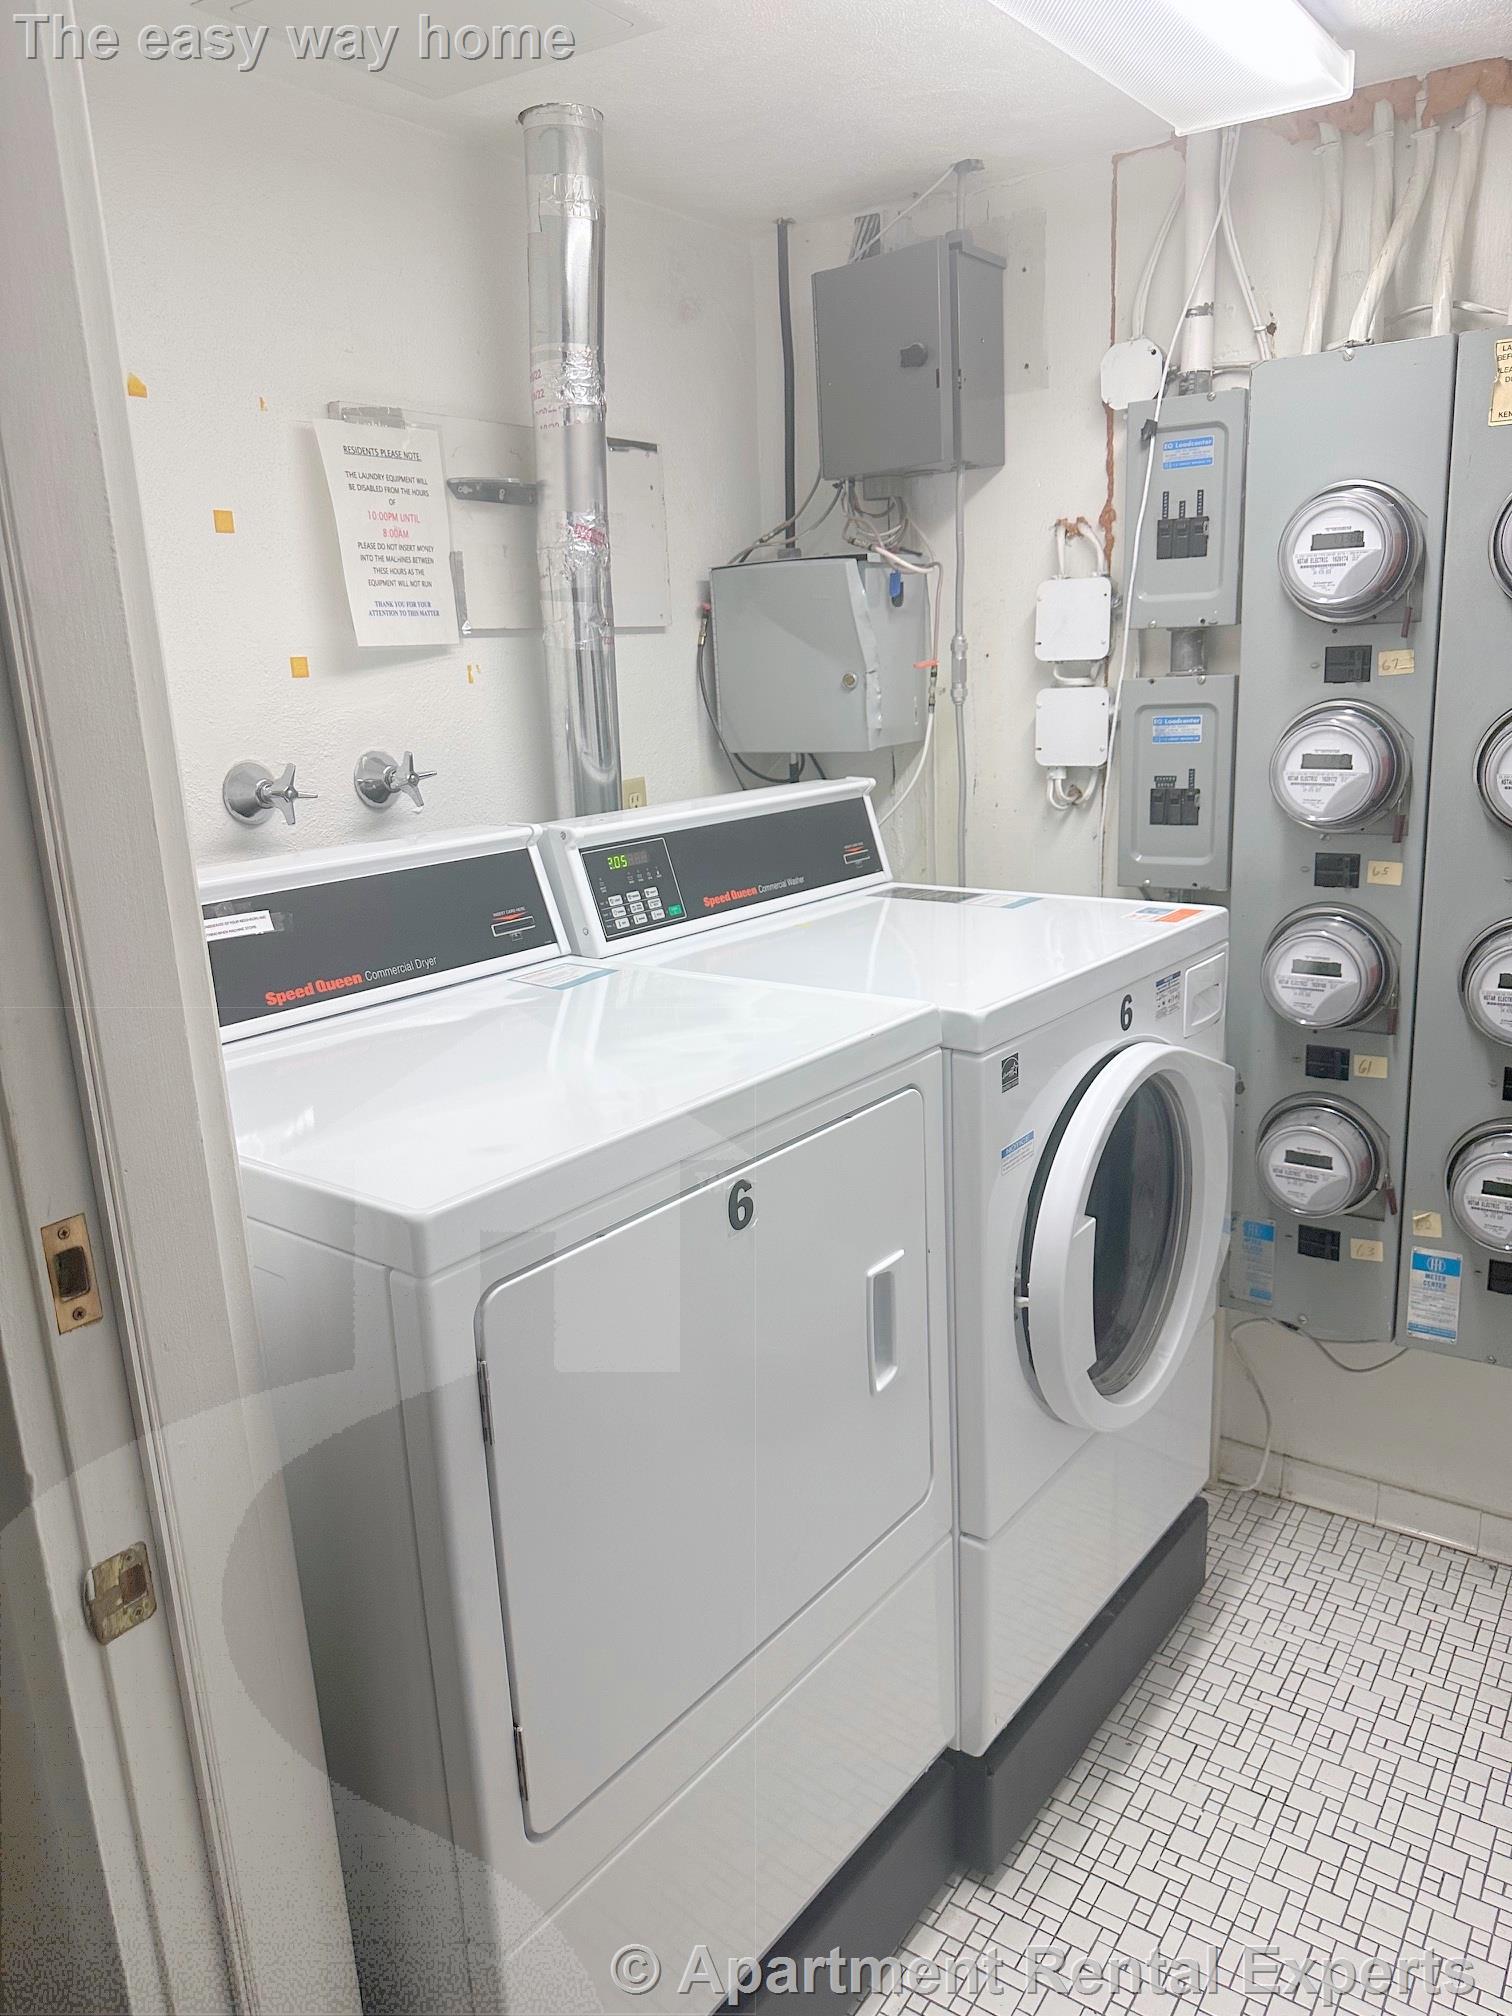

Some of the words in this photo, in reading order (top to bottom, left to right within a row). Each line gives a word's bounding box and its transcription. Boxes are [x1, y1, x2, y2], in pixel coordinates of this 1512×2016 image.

[343, 445, 379, 457] RESIDENTS
[380, 448, 402, 460] PLEASE
[344, 470, 357, 478] THE
[358, 472, 384, 481] LAUNDRY
[386, 474, 415, 484] EQUIPMENT
[357, 484, 383, 492] DISABLED
[412, 489, 429, 497] HOURS
[368, 511, 398, 521] 10:00PM
[400, 513, 420, 523] UNTIL
[383, 528, 409, 538] 8:00AM
[357, 541, 376, 550] PLEASE
[386, 555, 411, 563] MACHINES
[412, 556, 434, 564] BETWEEN
[373, 567, 389, 575] THESE
[368, 579, 397, 588] EQUIPMENT
[703, 889, 731, 908] Speed
[731, 886, 758, 900] Queen
[758, 880, 787, 894] Commercial
[787, 876, 804, 887] Washer
[265, 980, 315, 1006] Speed
[316, 973, 363, 993] Queen
[365, 960, 415, 982] Commercial
[415, 956, 437, 970] Dryer
[1120, 994, 1133, 1031] 6
[728, 1179, 754, 1230] 6
